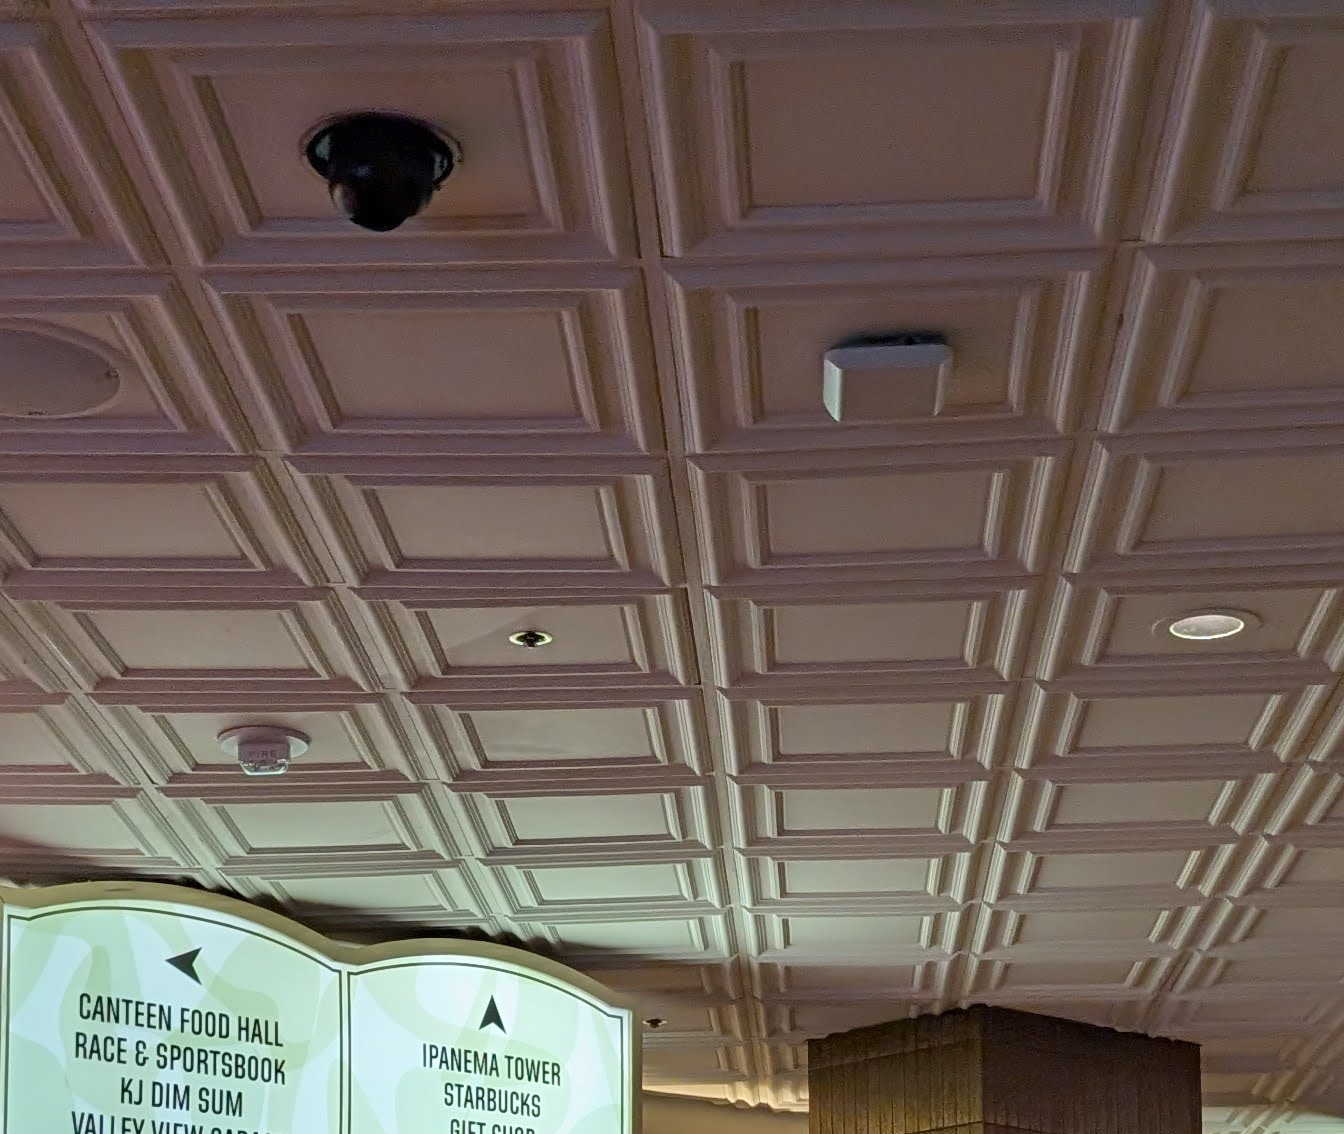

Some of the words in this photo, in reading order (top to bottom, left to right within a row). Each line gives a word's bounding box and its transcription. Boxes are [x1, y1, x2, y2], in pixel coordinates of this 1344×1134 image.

[79, 992, 172, 1032] CANTEEN
[180, 1006, 231, 1040] FOOD
[237, 1015, 284, 1048] HALL
[74, 1031, 128, 1065] RACE
[134, 1039, 150, 1067] &
[156, 1042, 287, 1086] SPORTSBOOK
[422, 1042, 500, 1078] IPANEMA
[503, 1054, 561, 1087] TOWER
[120, 1076, 144, 1106] KJ
[151, 1080, 191, 1112] DIM
[198, 1086, 243, 1118] SUM
[443, 1082, 541, 1118] STARBUCKS
